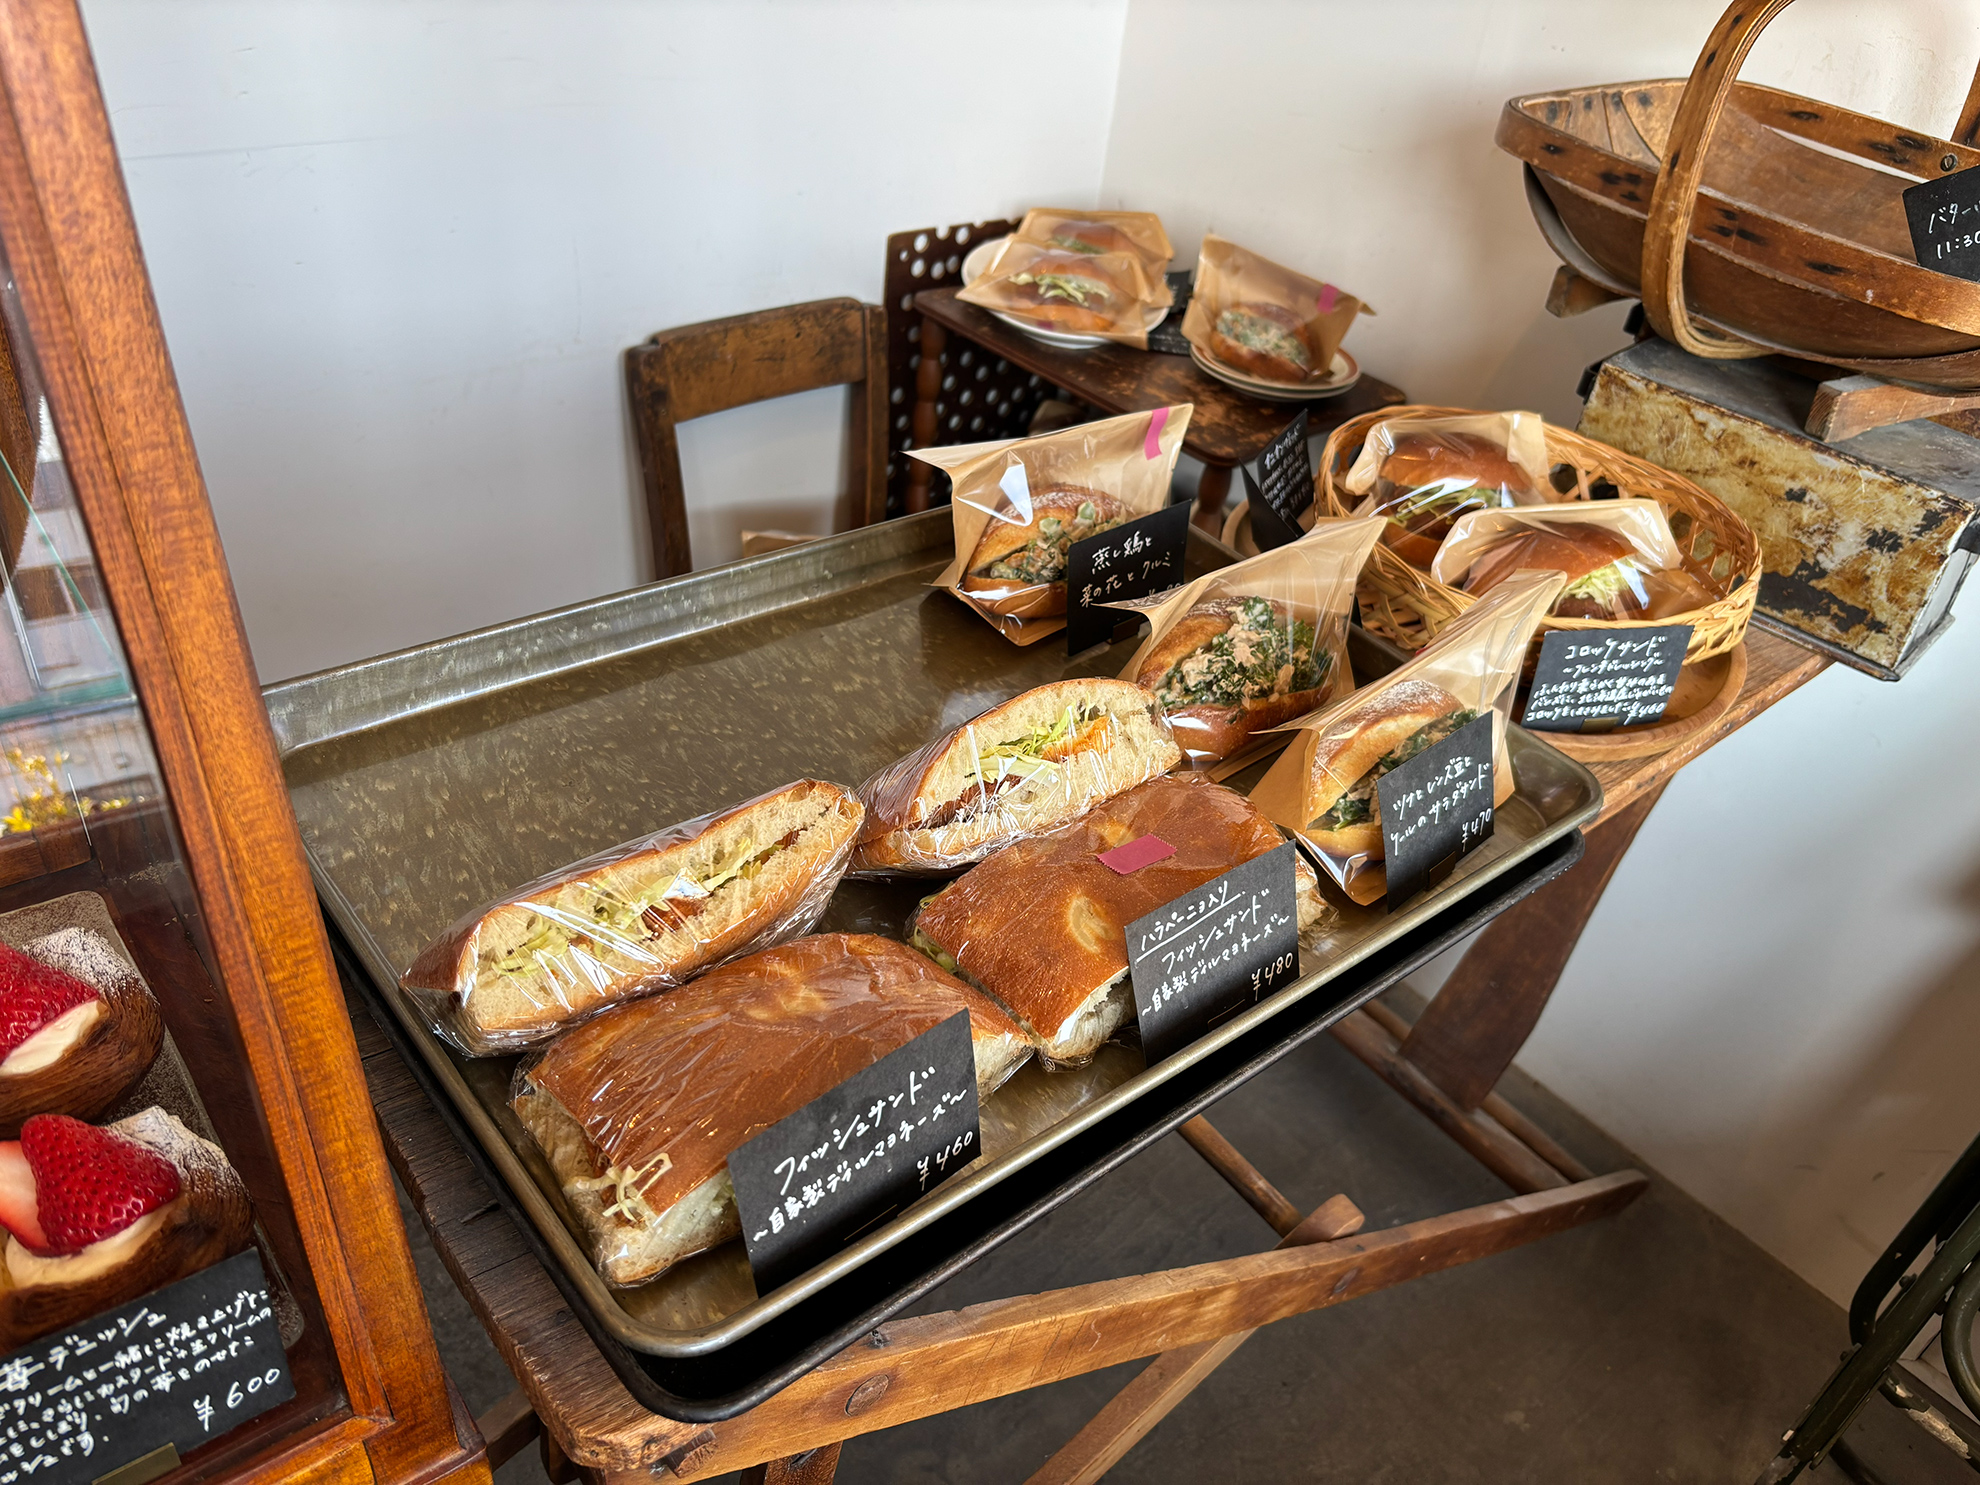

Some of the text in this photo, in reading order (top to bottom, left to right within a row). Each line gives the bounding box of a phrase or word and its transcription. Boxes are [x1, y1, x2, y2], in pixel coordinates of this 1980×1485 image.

[1928, 200, 1980, 234] バター
[1091, 530, 1154, 575] 蒸し鶏と
[1564, 635, 1668, 660] コロッケサンド
[1461, 808, 1492, 852] ¥470
[1162, 888, 1270, 974] フィッシュサンド
[1251, 953, 1293, 1001] ¥480
[774, 1066, 936, 1195] フィッシュサンド
[916, 1131, 974, 1191] ¥460
[193, 1368, 281, 1432] ¥600
